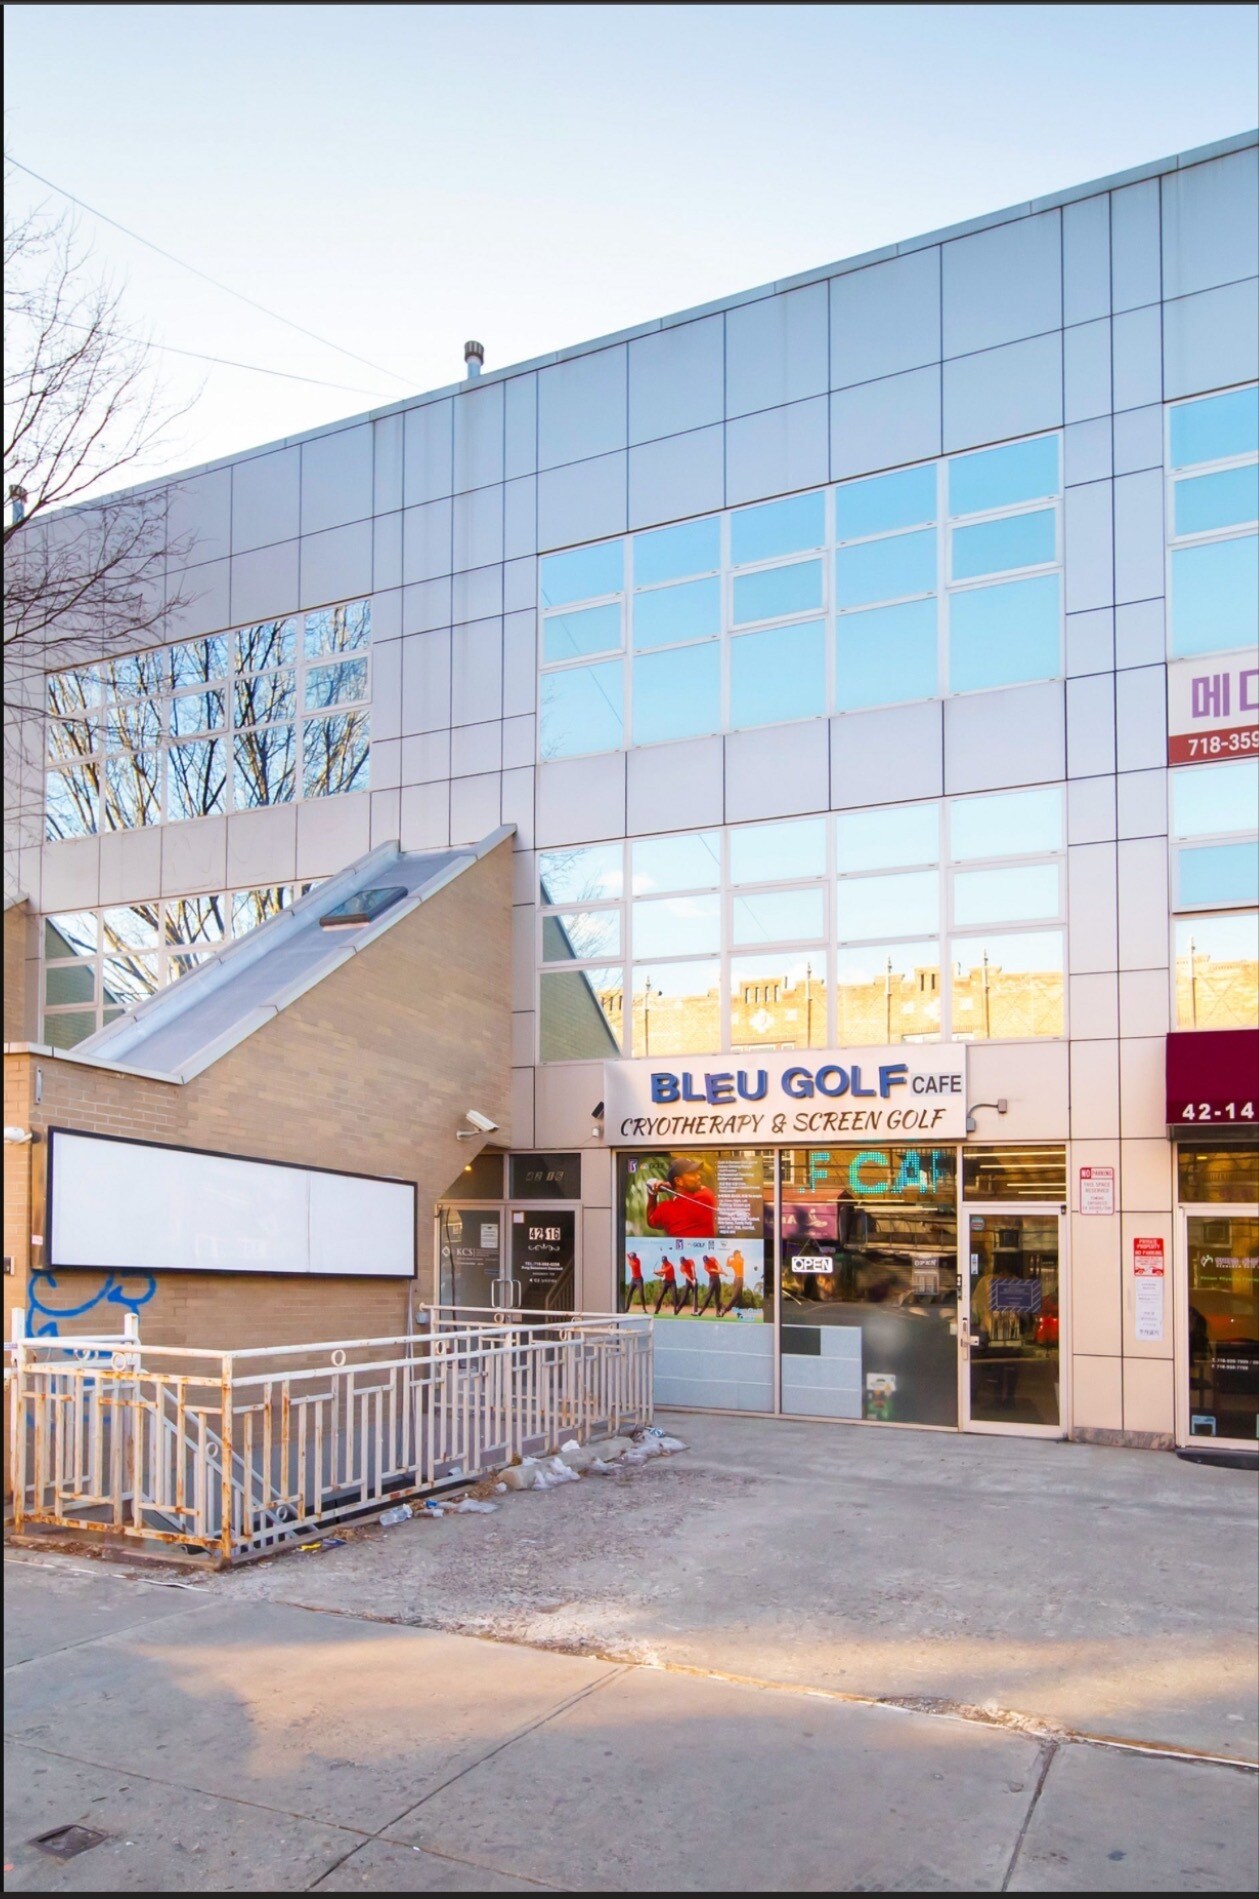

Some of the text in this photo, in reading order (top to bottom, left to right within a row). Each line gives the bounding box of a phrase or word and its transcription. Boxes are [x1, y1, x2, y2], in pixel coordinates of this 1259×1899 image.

[651, 1064, 962, 1105] BLEU GOLF CAFE
[1182, 1102, 1254, 1120] 42-14
[621, 1108, 946, 1136] CRYOTHERAPY & SCREEN GOLF
[1081, 1169, 1091, 1178] NO
[793, 1258, 832, 1271] OPEN
